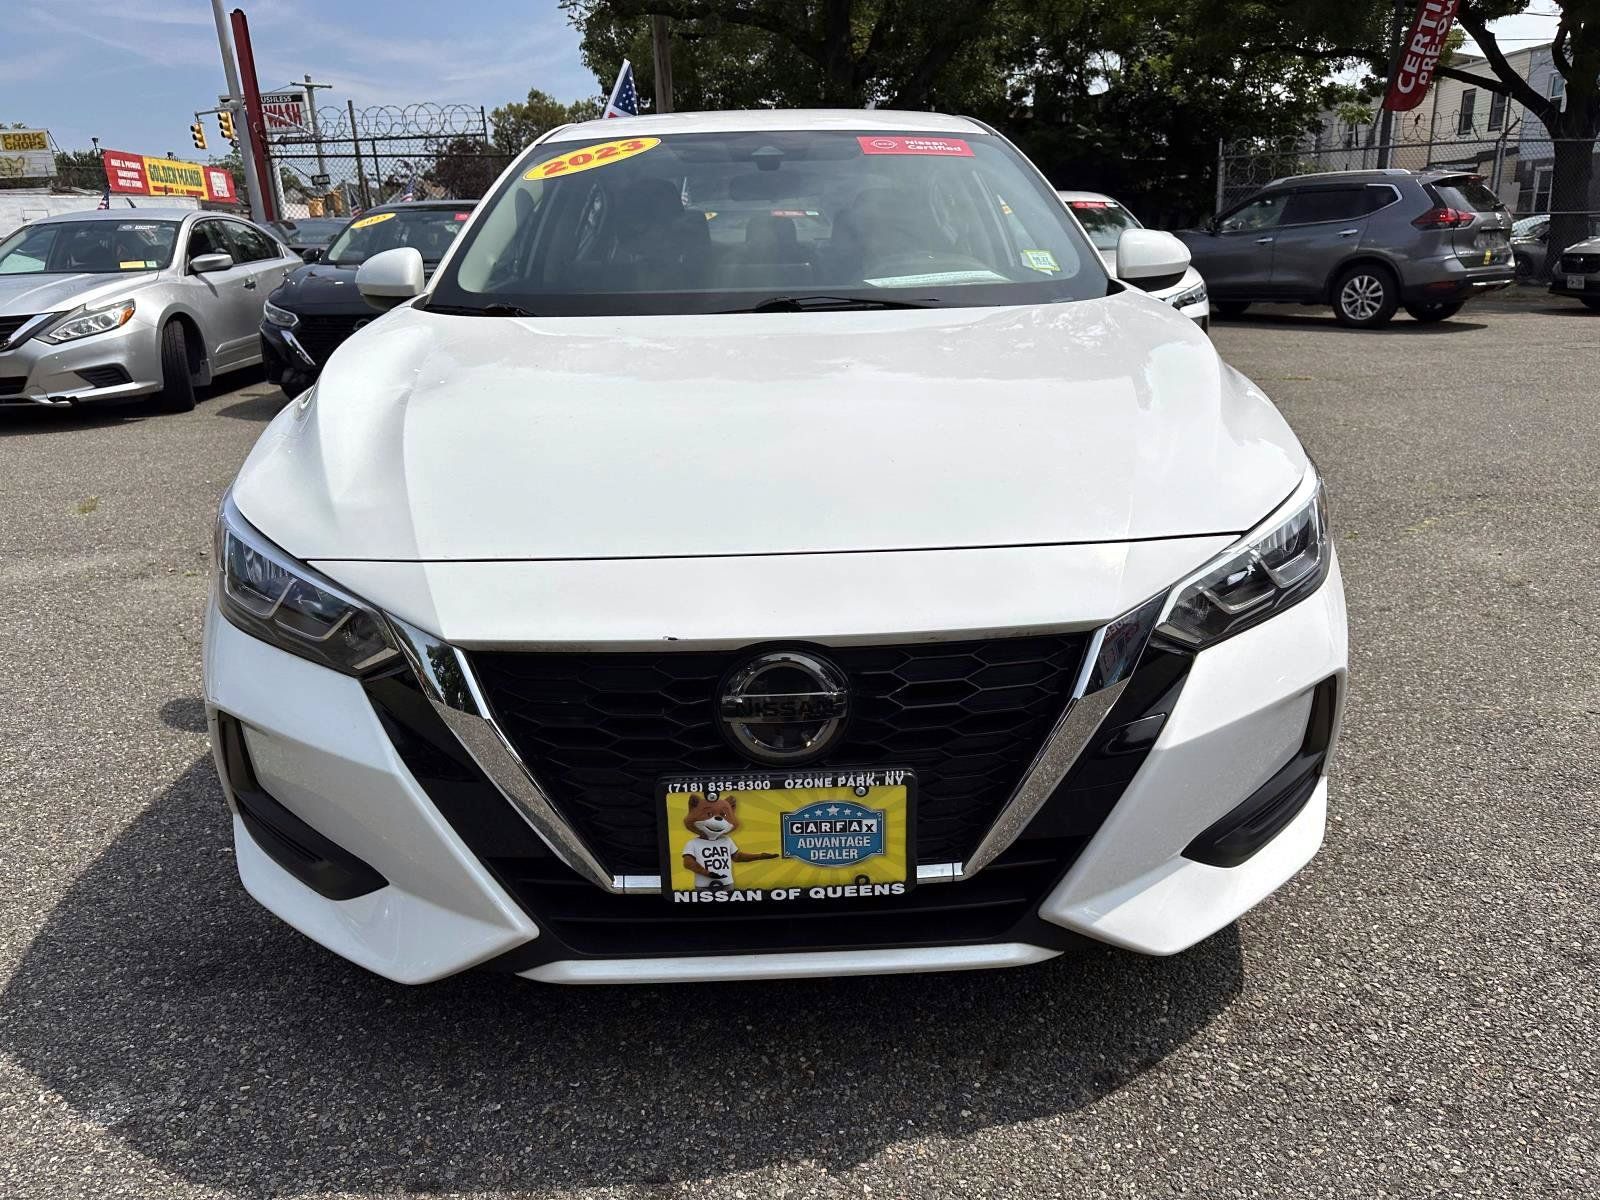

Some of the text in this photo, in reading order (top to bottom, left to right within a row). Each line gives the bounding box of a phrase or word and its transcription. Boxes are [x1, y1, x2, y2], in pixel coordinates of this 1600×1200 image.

[1398, 0, 1443, 93] CERTI
[261, 96, 292, 104] USHLESS
[263, 103, 303, 128] WASH
[3, 132, 43, 142] PORK
[5, 142, 47, 150] CHOPS
[543, 141, 646, 176] 2023
[148, 163, 177, 185] GOLDEN
[176, 168, 203, 187] MANGO
[735, 700, 840, 718] NISSAN
[668, 775, 904, 793] (718) 835-8300 OZONE PARK, NY
[792, 821, 874, 833] CARFAX
[797, 836, 871, 849] ADVANTAGE
[701, 846, 728, 859] CAR
[810, 848, 858, 860] DEALER
[704, 859, 729, 870] FOX
[674, 883, 905, 903] NISSAN OF QUEENS
